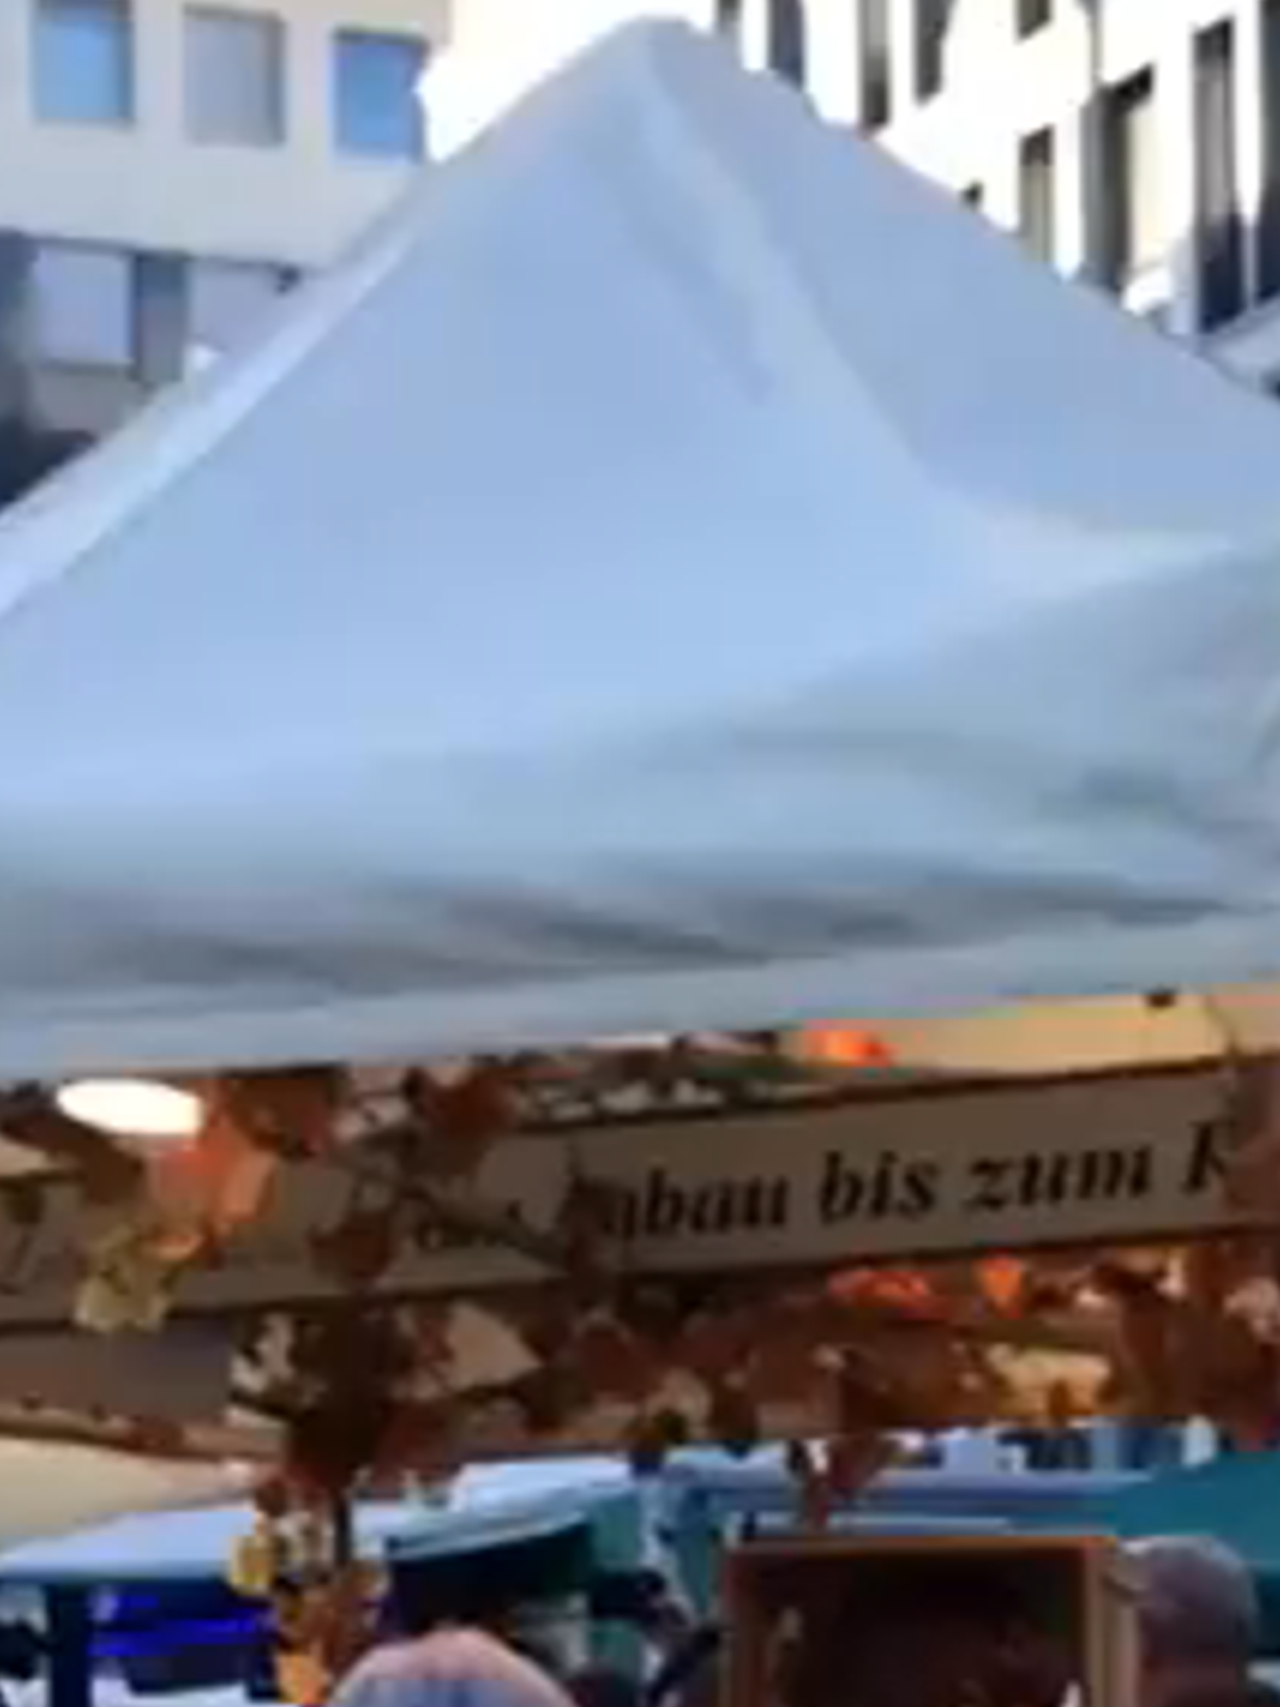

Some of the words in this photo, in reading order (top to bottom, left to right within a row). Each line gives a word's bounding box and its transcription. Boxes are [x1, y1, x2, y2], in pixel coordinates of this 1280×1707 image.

[588, 1163, 790, 1241] nbau
[820, 1149, 937, 1225] bis
[962, 1143, 1152, 1213] zum
